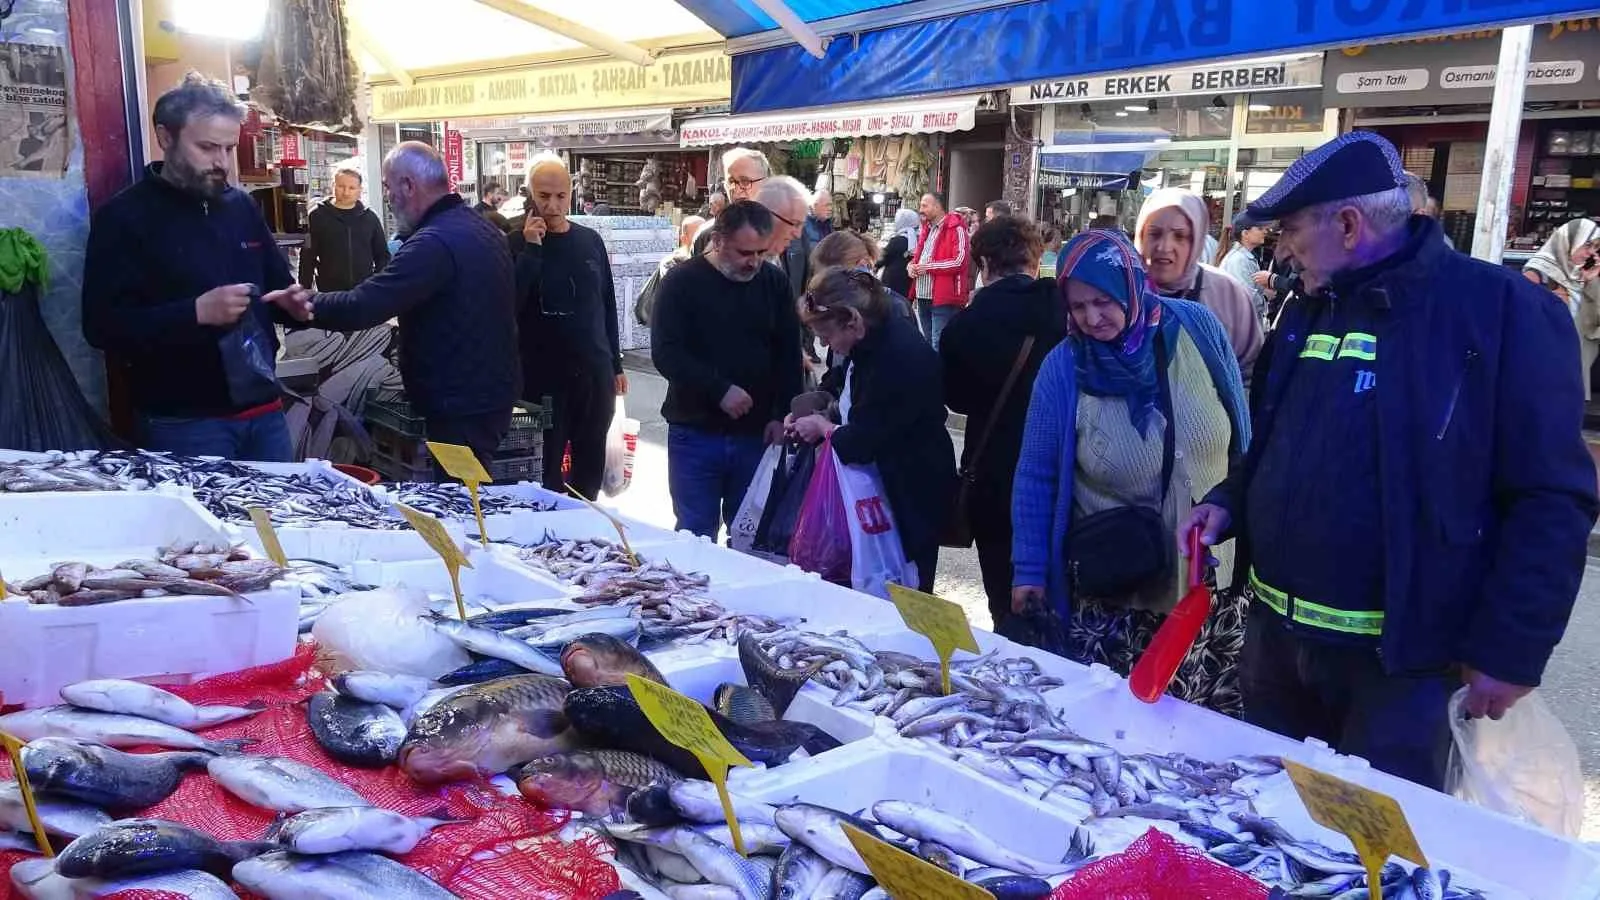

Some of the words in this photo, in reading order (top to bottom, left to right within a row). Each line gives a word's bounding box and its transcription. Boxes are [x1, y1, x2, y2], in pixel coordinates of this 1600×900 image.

[1030, 82, 1089, 100] NAZAR
[1105, 74, 1171, 95] ERKEK
[1192, 62, 1286, 90] BERBERİ
[1357, 76, 1381, 88] Şam
